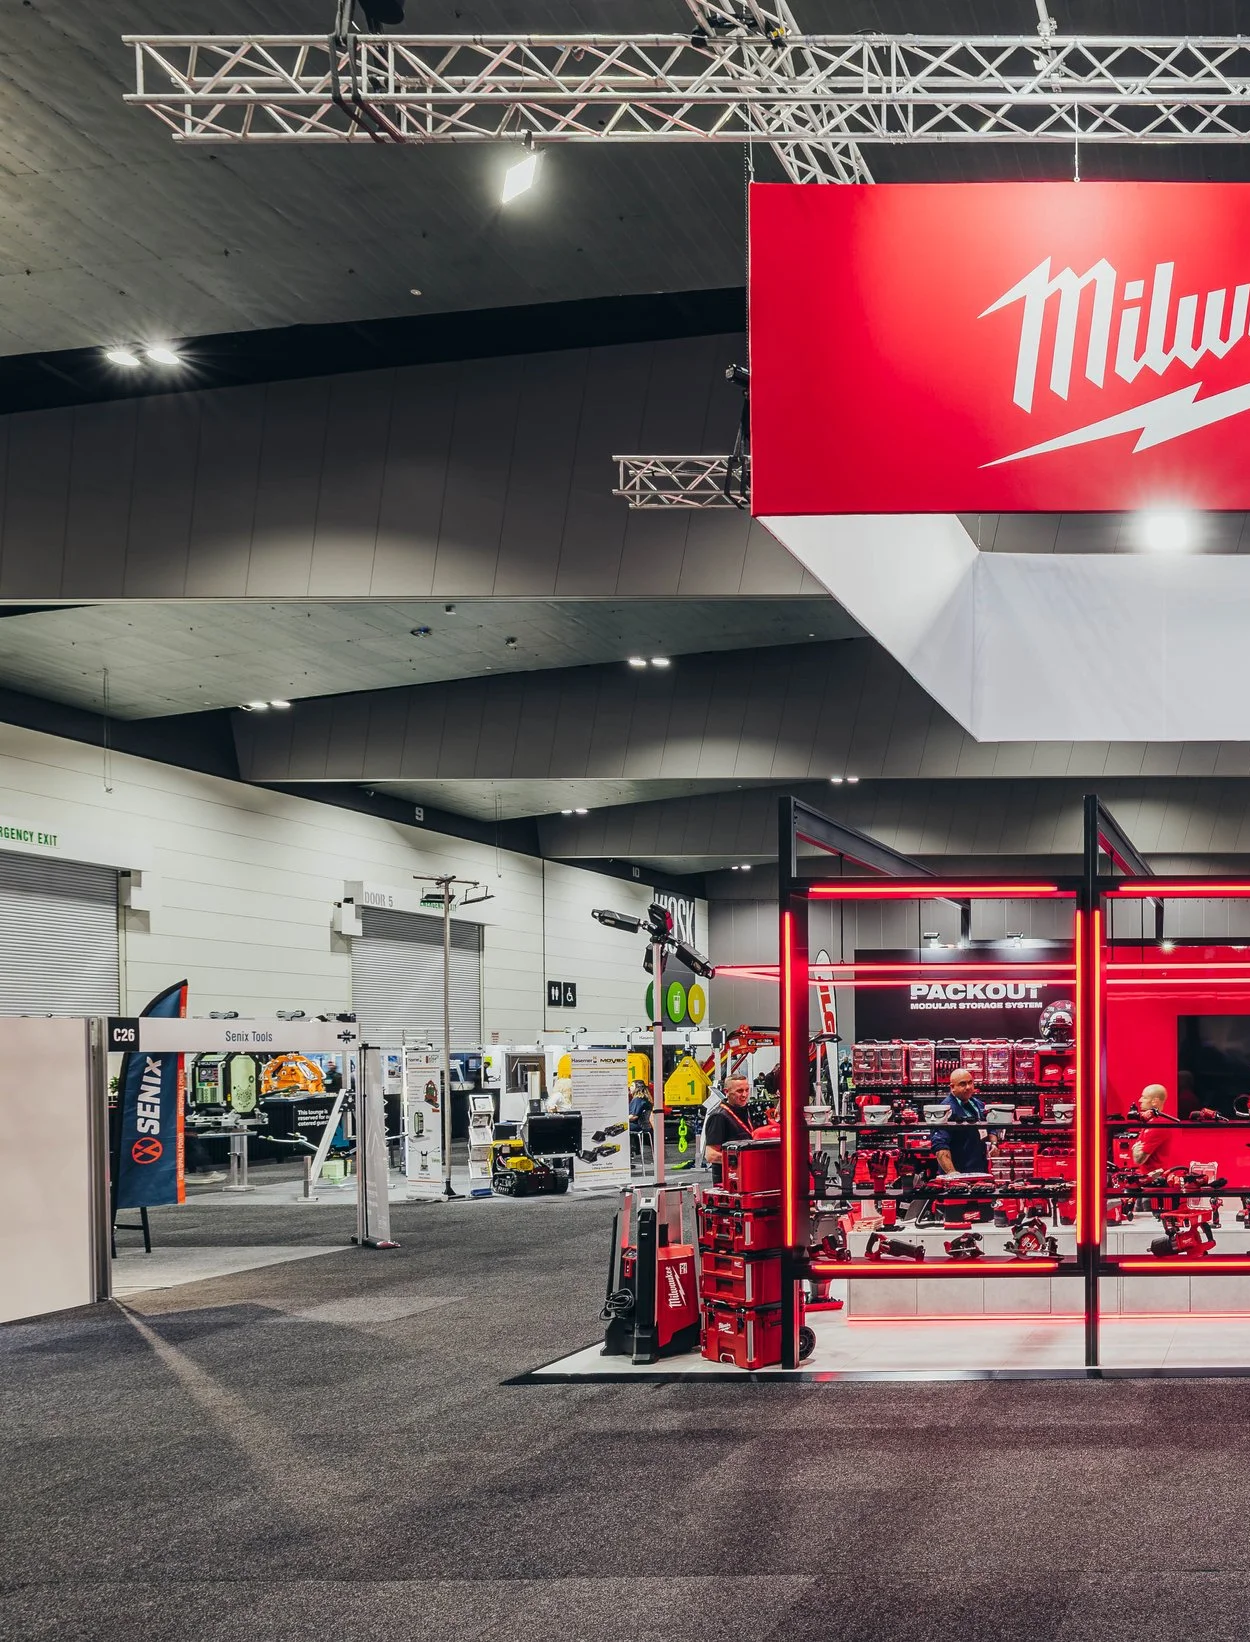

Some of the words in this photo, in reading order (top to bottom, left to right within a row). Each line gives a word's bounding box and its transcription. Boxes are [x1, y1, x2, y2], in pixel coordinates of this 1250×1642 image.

[415, 807, 424, 821] 9
[38, 833, 58, 846] EXIT
[632, 866, 640, 878] 10
[364, 892, 386, 906] DOOR
[388, 896, 394, 907] 5
[910, 984, 1043, 999] PACKOUT
[910, 1002, 957, 1010] MODULAR
[113, 1028, 135, 1042] C26
[225, 1031, 249, 1042] Senix
[252, 1031, 273, 1042] Tools
[629, 1066, 636, 1079] 1
[687, 1080, 695, 1095] 1
[137, 1056, 162, 1135] SENIX
